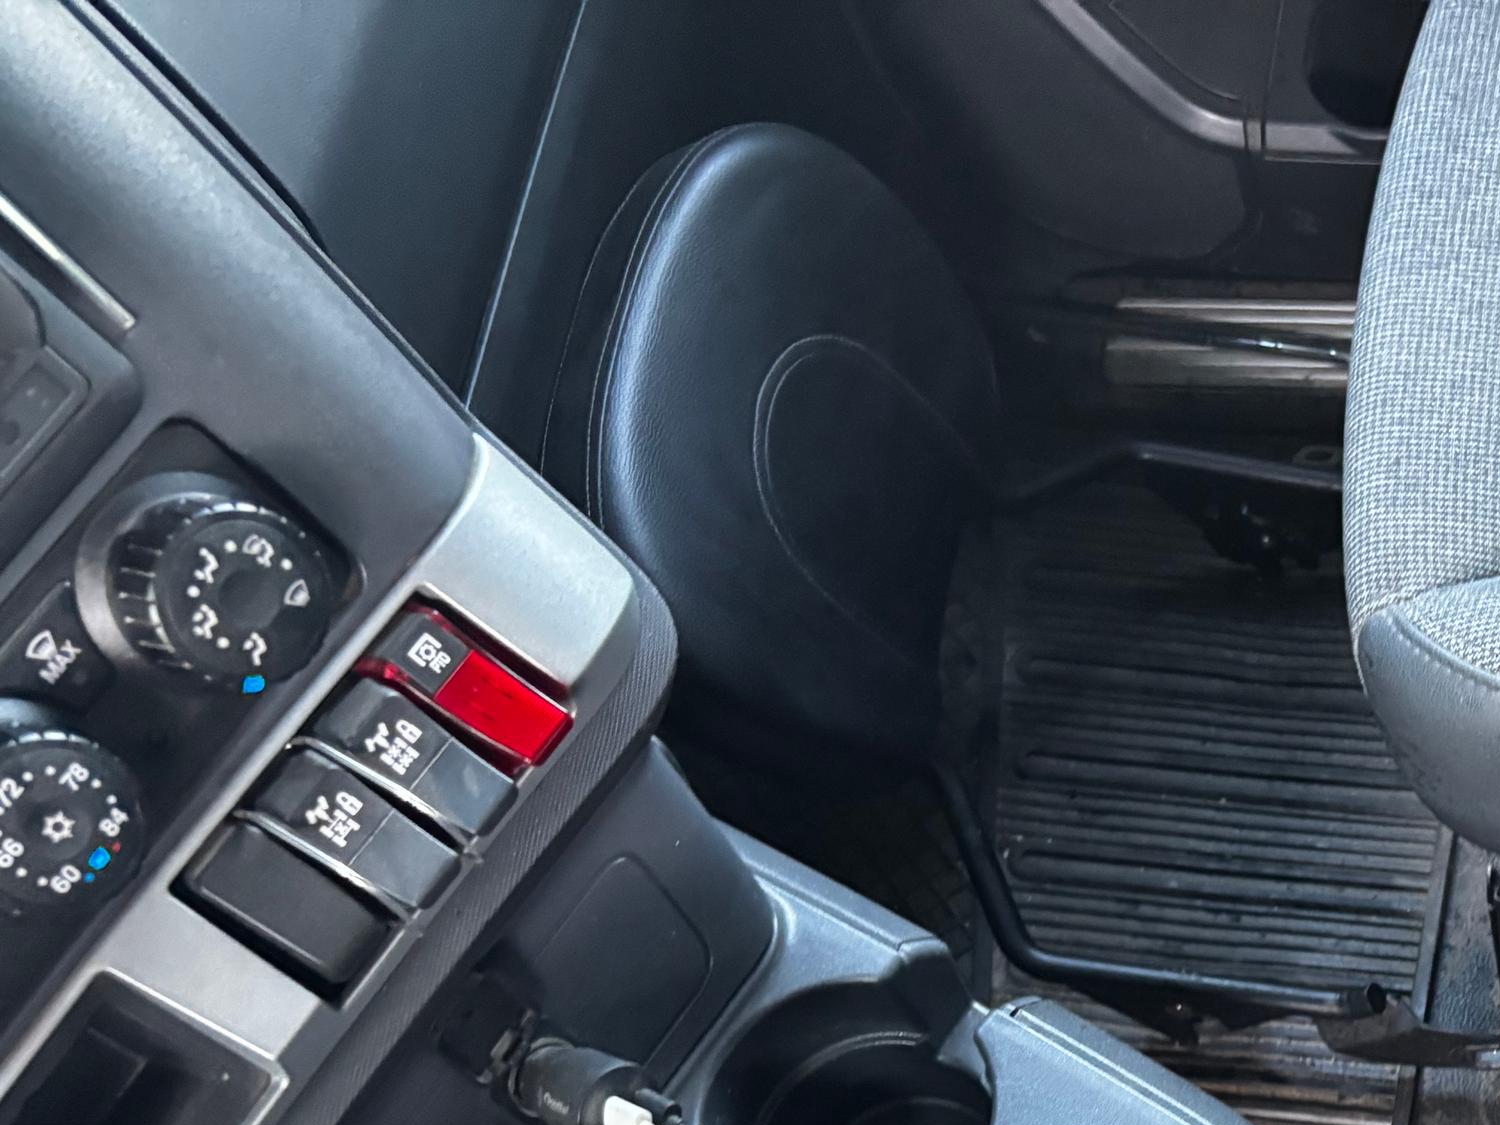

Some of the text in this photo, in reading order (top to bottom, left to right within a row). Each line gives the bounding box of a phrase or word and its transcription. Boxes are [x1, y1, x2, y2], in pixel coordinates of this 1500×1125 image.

[38, 639, 82, 685] MAX
[428, 651, 452, 674] PTO
[58, 762, 90, 792] 78
[98, 807, 130, 838] 84
[50, 864, 82, 894] 60
